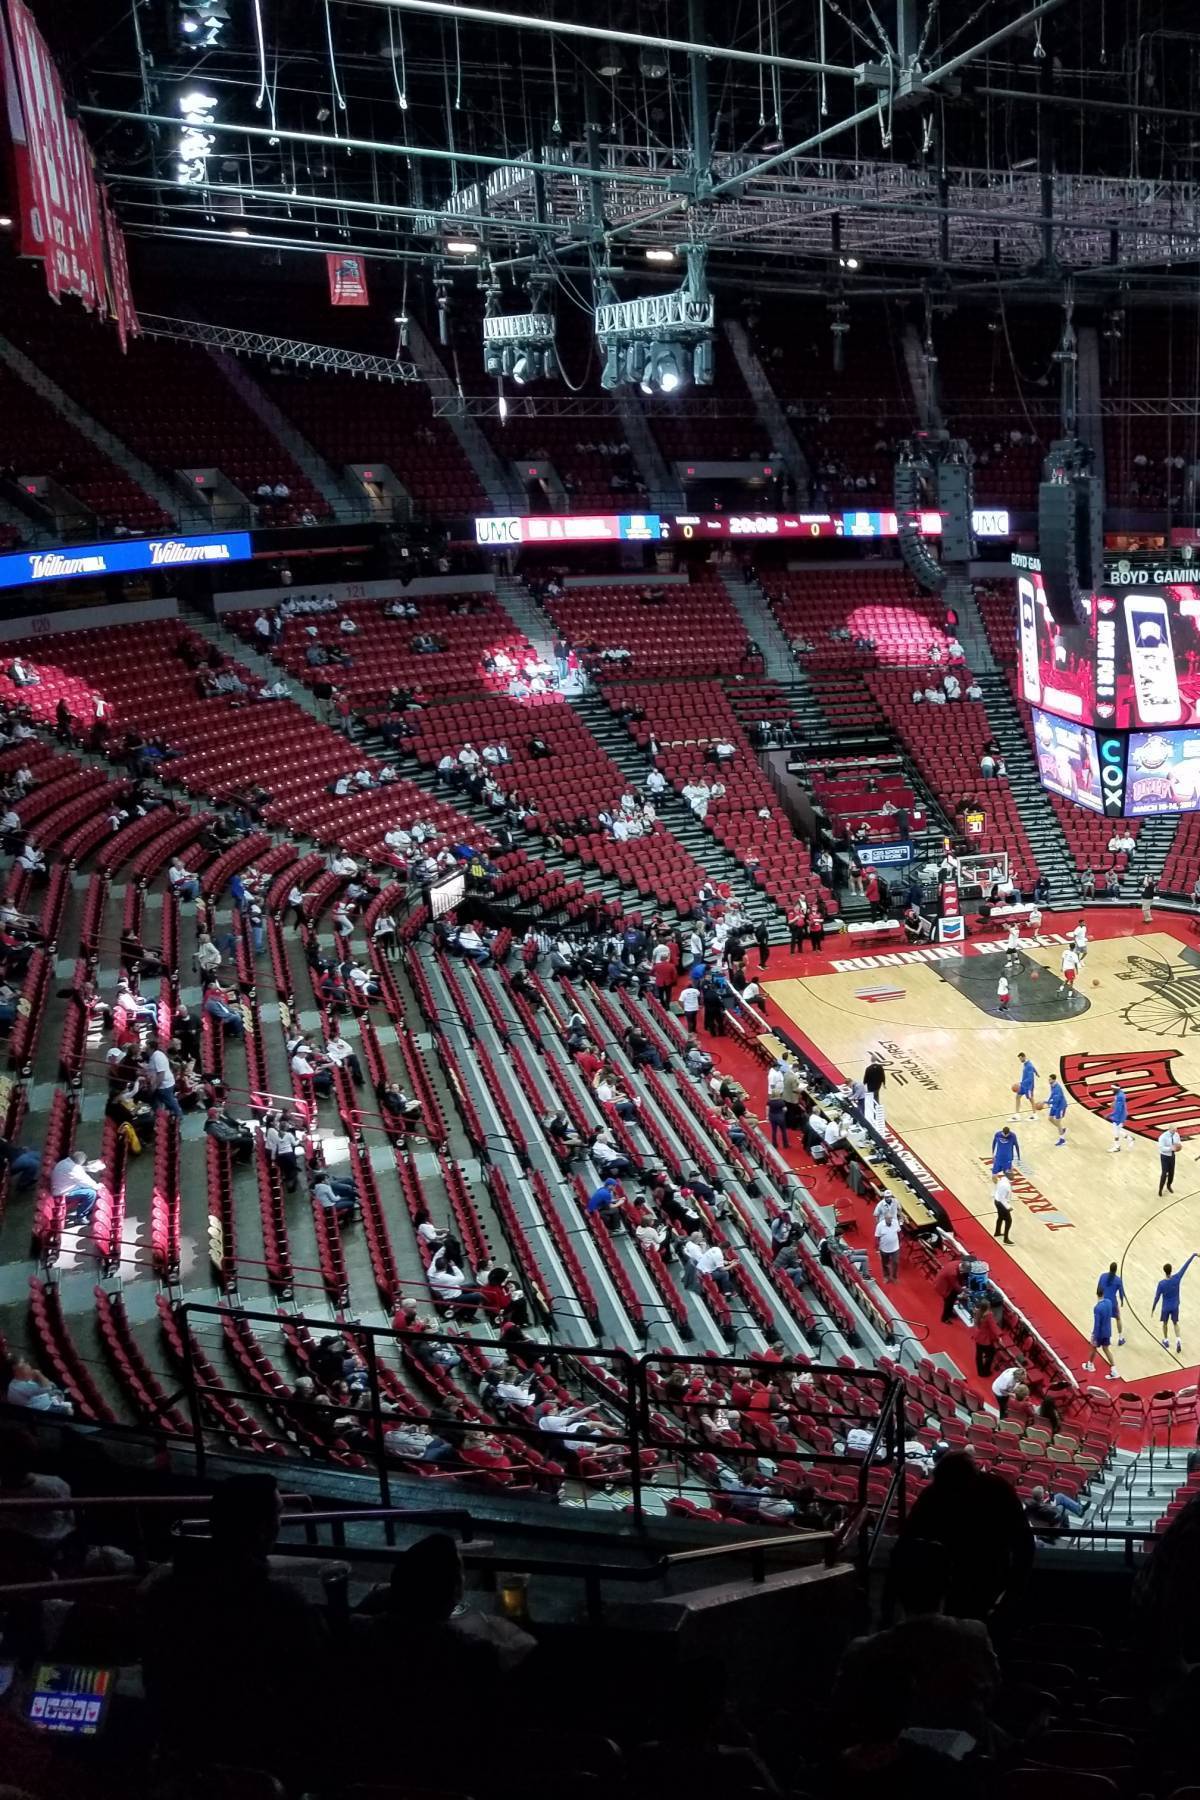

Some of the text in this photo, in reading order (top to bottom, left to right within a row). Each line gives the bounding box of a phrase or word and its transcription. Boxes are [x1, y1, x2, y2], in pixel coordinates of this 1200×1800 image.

[478, 521, 520, 541] UMC
[683, 525, 693, 538] 0
[729, 517, 778, 533] 20:05
[811, 523, 820, 536] 0
[149, 541, 204, 564] William
[1011, 552, 1027, 567] BOYD
[29, 554, 84, 578] William
[1111, 571, 1149, 585] BOYD
[1102, 740, 1124, 808] COX
[969, 821, 981, 832] 30
[901, 1058, 943, 1091] AMERICA
